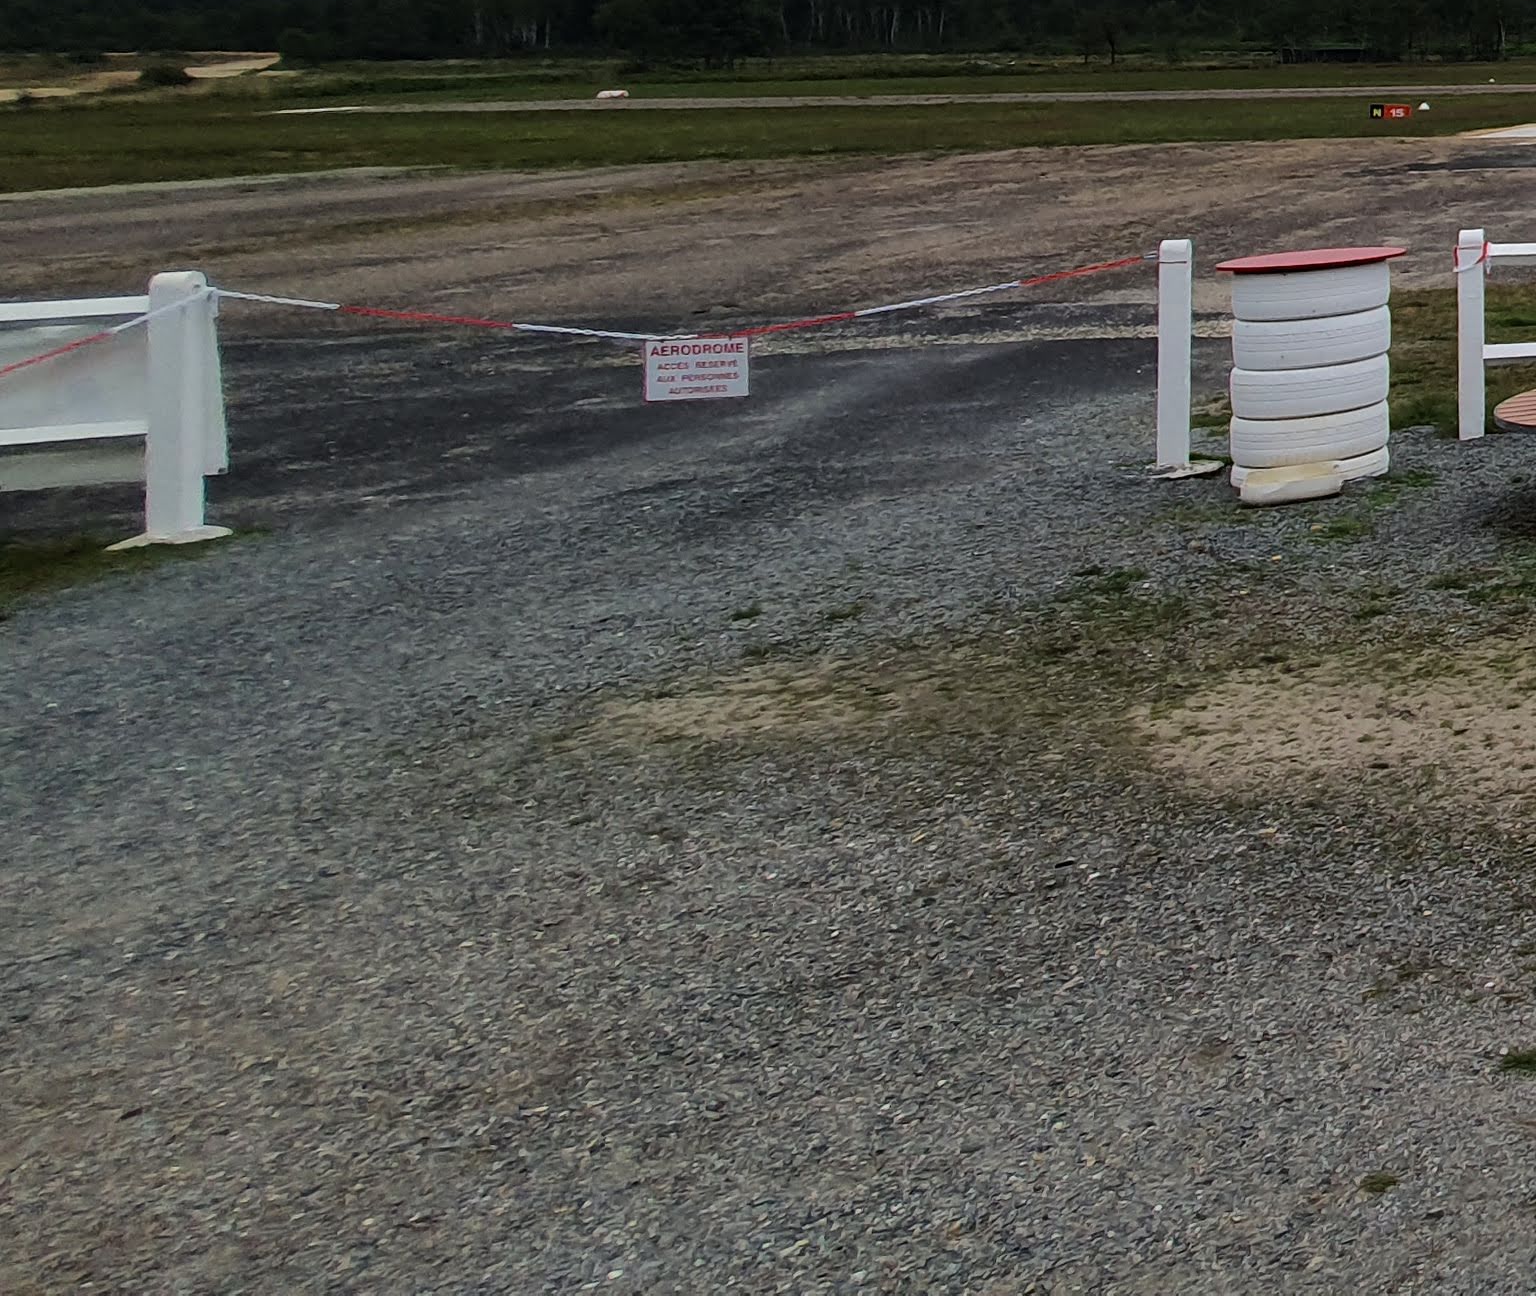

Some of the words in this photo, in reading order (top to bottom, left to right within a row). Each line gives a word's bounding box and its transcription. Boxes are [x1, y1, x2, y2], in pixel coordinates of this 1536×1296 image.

[1373, 109, 1382, 117] N
[1390, 109, 1404, 117] 15
[650, 343, 744, 357] AERODROME
[681, 372, 739, 382] PERSONNES
